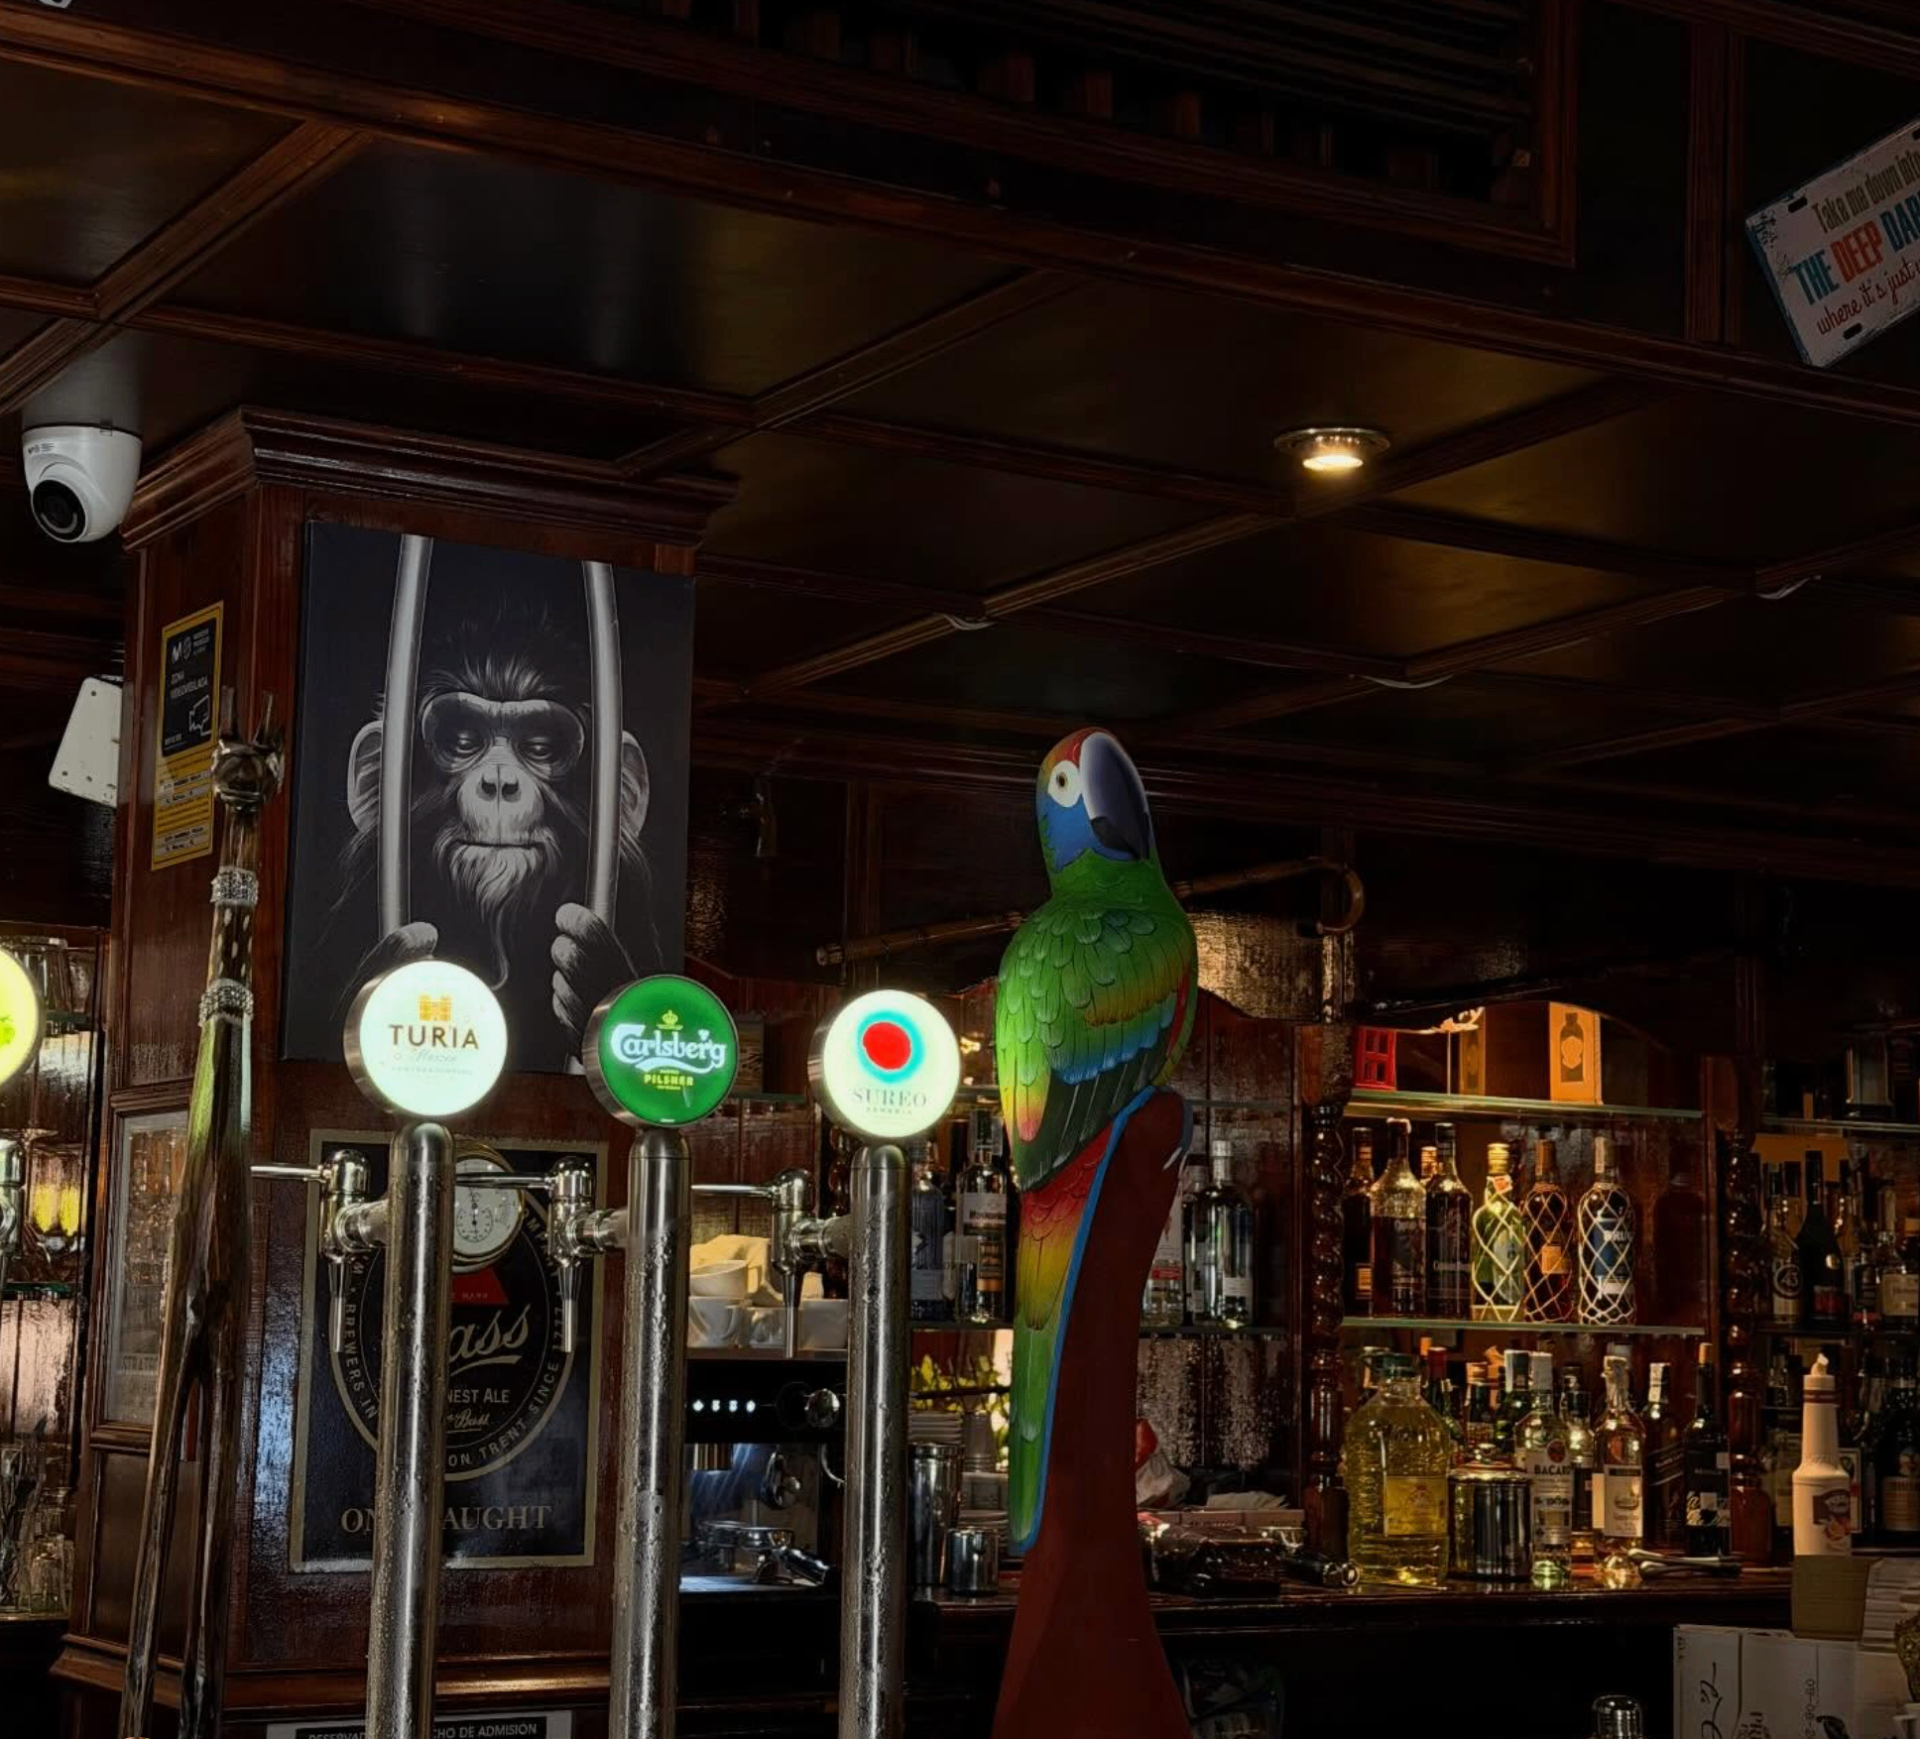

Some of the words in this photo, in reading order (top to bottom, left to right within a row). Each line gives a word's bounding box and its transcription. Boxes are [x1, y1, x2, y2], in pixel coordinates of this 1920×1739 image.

[1812, 197, 1850, 233] Take
[1845, 185, 1869, 216] me
[1864, 164, 1903, 204] down
[1793, 250, 1840, 305] THE
[1830, 220, 1884, 283] DEEP
[1880, 190, 1920, 252] DAR
[1817, 306, 1863, 335] where
[1859, 278, 1886, 307] it's
[1884, 257, 1916, 304] just
[388, 1024, 479, 1049] TURIA
[610, 1023, 727, 1072] Carlsberg
[644, 1074, 694, 1086] PILSNER
[449, 1303, 531, 1363] ass
[361, 1398, 378, 1419] IN
[447, 1389, 479, 1403] NEST
[482, 1388, 512, 1403] ALE
[448, 1453, 471, 1467] ON
[479, 1418, 527, 1459] TRENT
[528, 1360, 559, 1415] SINCE
[441, 1506, 552, 1530] AUGHT
[459, 1726, 475, 1739] DE
